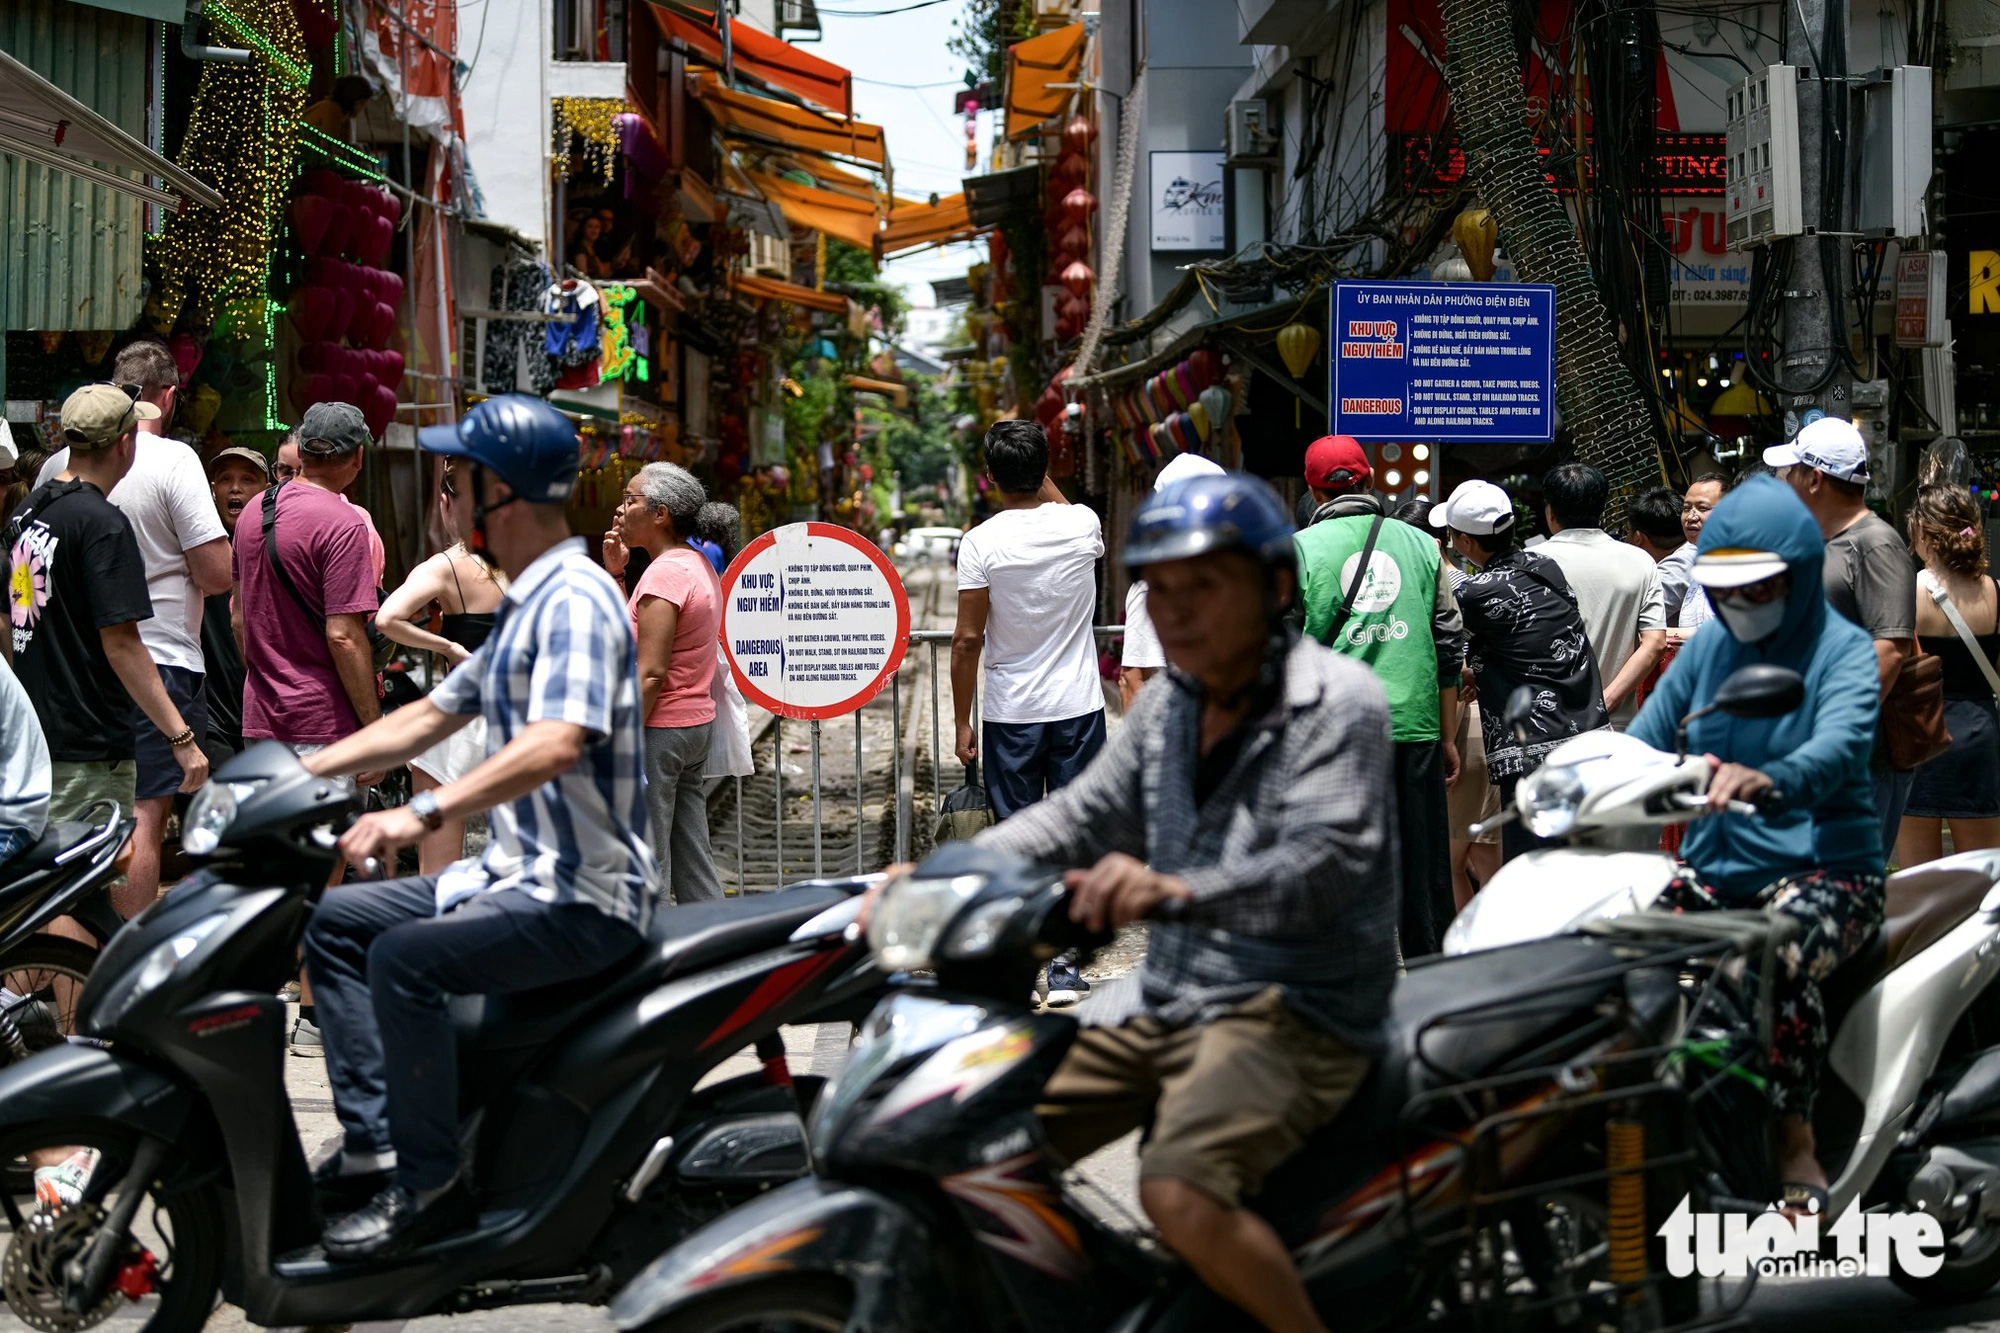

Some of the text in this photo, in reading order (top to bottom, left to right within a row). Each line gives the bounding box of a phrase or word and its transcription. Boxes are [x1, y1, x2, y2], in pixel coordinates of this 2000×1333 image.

[1907, 259, 1928, 273] ASIA
[1358, 291, 1530, 308] ỦY BAN NHÂN DÂN PHƯỜNG ĐIỆN BIÊN
[1349, 320, 1397, 340] KHU VỰC
[1342, 338, 1403, 359] NGUY HIỂM
[1414, 379, 1421, 387] DO
[1422, 379, 1433, 387] NOT
[1461, 380, 1482, 388] CROWD,
[1482, 380, 1495, 388] TAKE
[1497, 380, 1519, 389] PHOTOS,
[1520, 381, 1540, 389] VIDEOS.
[1435, 393, 1452, 401] WALK,
[1453, 393, 1472, 402] STAND,
[1473, 393, 1481, 401] SIT
[1482, 393, 1489, 401] ON
[1342, 398, 1402, 414] DANGEROUS
[1457, 407, 1478, 415] CHAIRS,
[1415, 417, 1426, 425] AND
[1427, 417, 1444, 425] ALONG
[742, 573, 774, 592] KHU VỰC
[737, 591, 779, 612] NGUY HIỂM
[1346, 614, 1409, 646] Grab
[736, 640, 780, 655] DANGEROUS
[818, 648, 833, 656] STAND,
[749, 662, 768, 677] AREA
